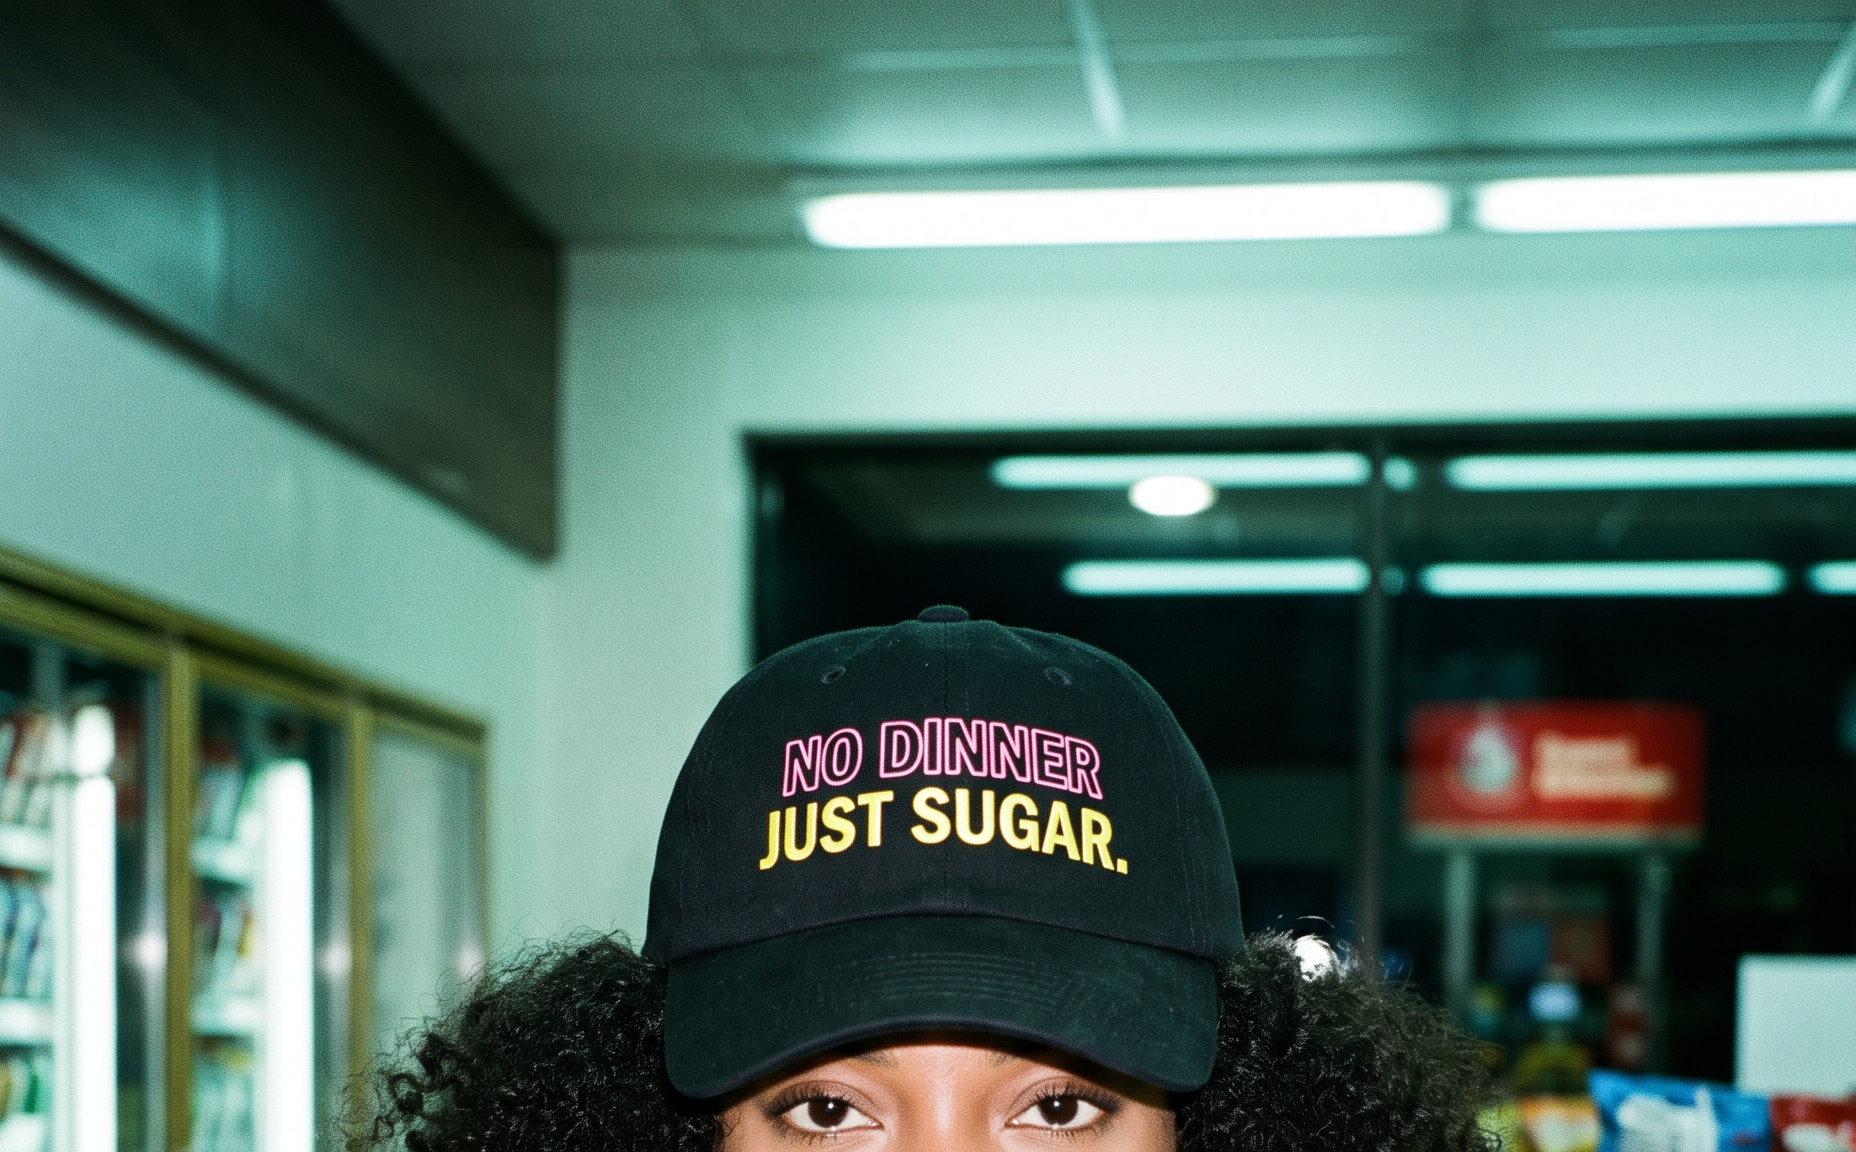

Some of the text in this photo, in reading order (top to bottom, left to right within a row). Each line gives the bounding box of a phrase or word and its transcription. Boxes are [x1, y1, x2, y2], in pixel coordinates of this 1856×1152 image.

[782, 717, 1103, 800] NO DINNER
[759, 786, 1128, 875] JUST SUGAR.
